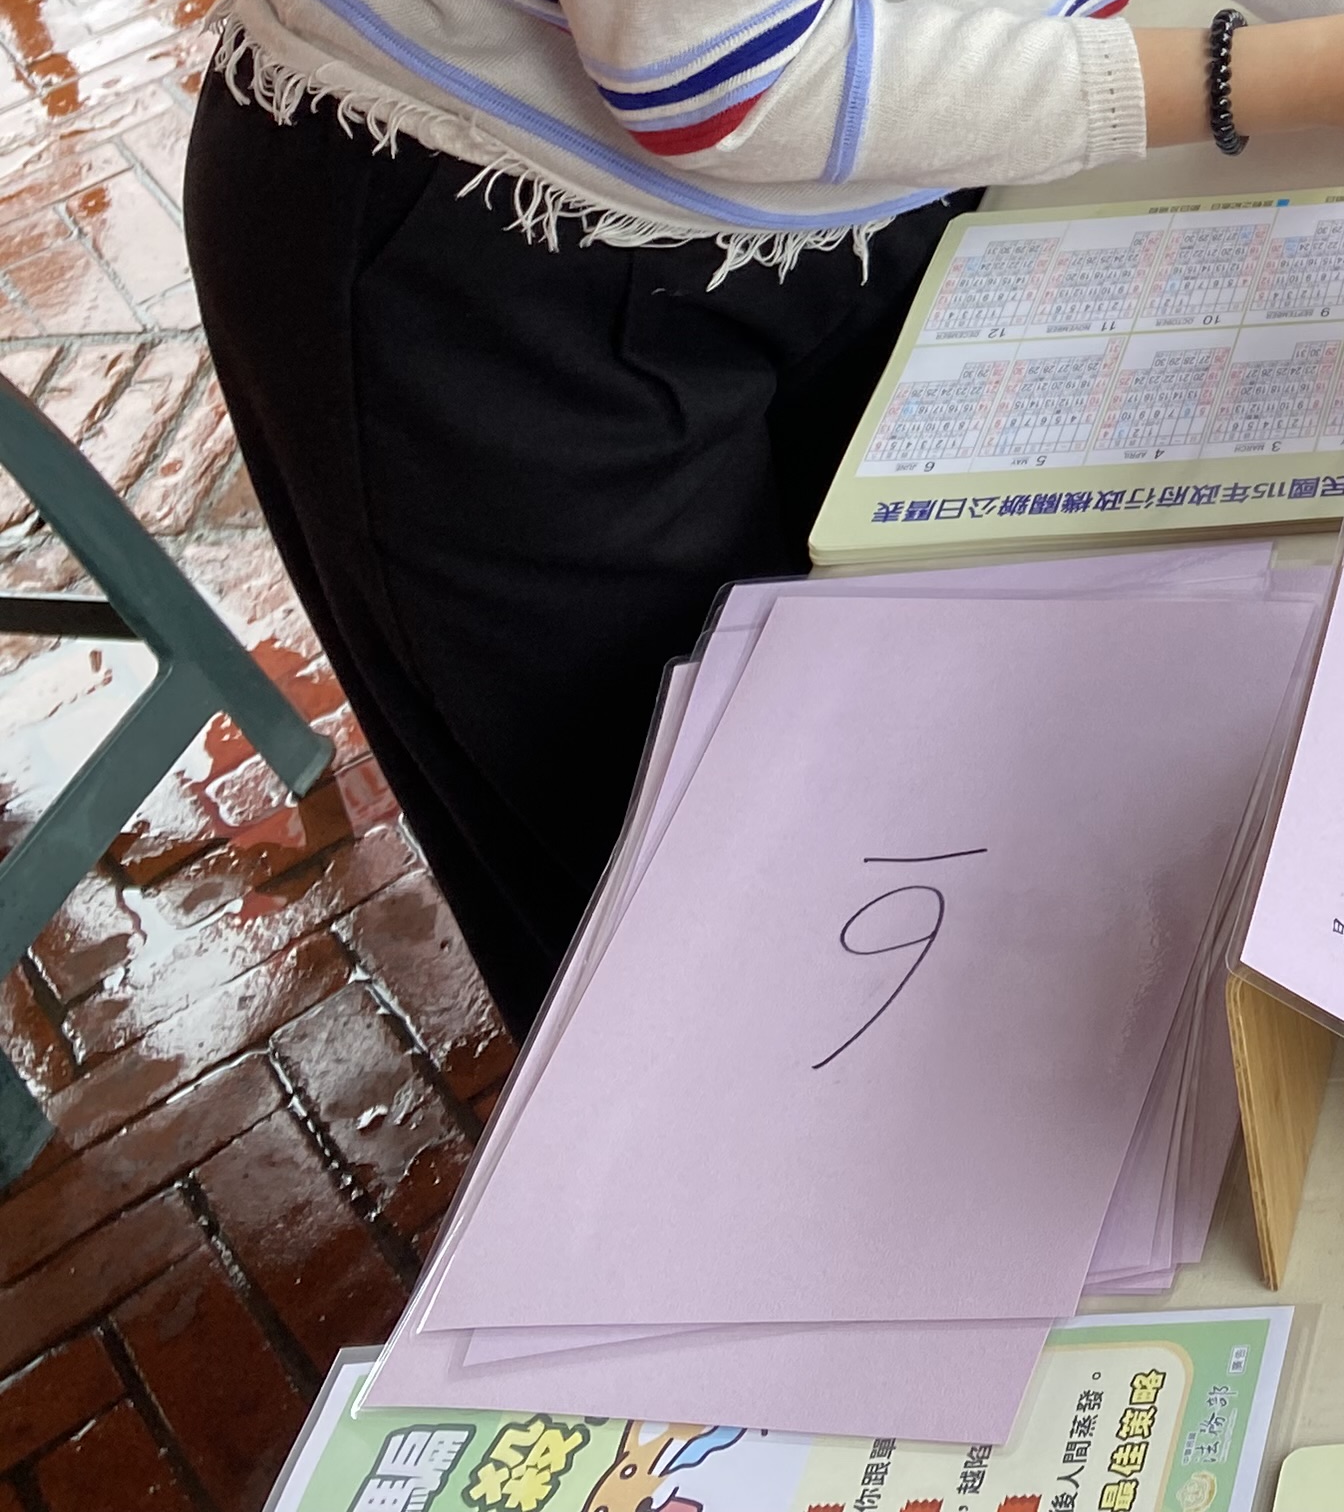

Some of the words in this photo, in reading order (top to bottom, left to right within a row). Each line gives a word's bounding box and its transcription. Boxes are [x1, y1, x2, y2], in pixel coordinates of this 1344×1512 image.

[1266, 309, 1314, 319] SEPTEMBER
[1320, 308, 1330, 317] 9
[1155, 318, 1195, 327] OCTOBER
[1202, 315, 1221, 325] 10
[1046, 323, 1092, 333] NOVEMBER
[1100, 321, 1116, 331] 11
[936, 330, 981, 340] DECEMBER
[988, 327, 1006, 338] 12
[1234, 443, 1265, 453] MARCH
[1271, 441, 1282, 452] 3
[1124, 451, 1148, 459] APRIL
[1154, 449, 1165, 460] 4
[1035, 455, 1047, 466] 5
[924, 461, 935, 472] 6
[1195, 1385, 1238, 1464] 法務部
[1098, 1369, 1166, 1512] 最佳策略
